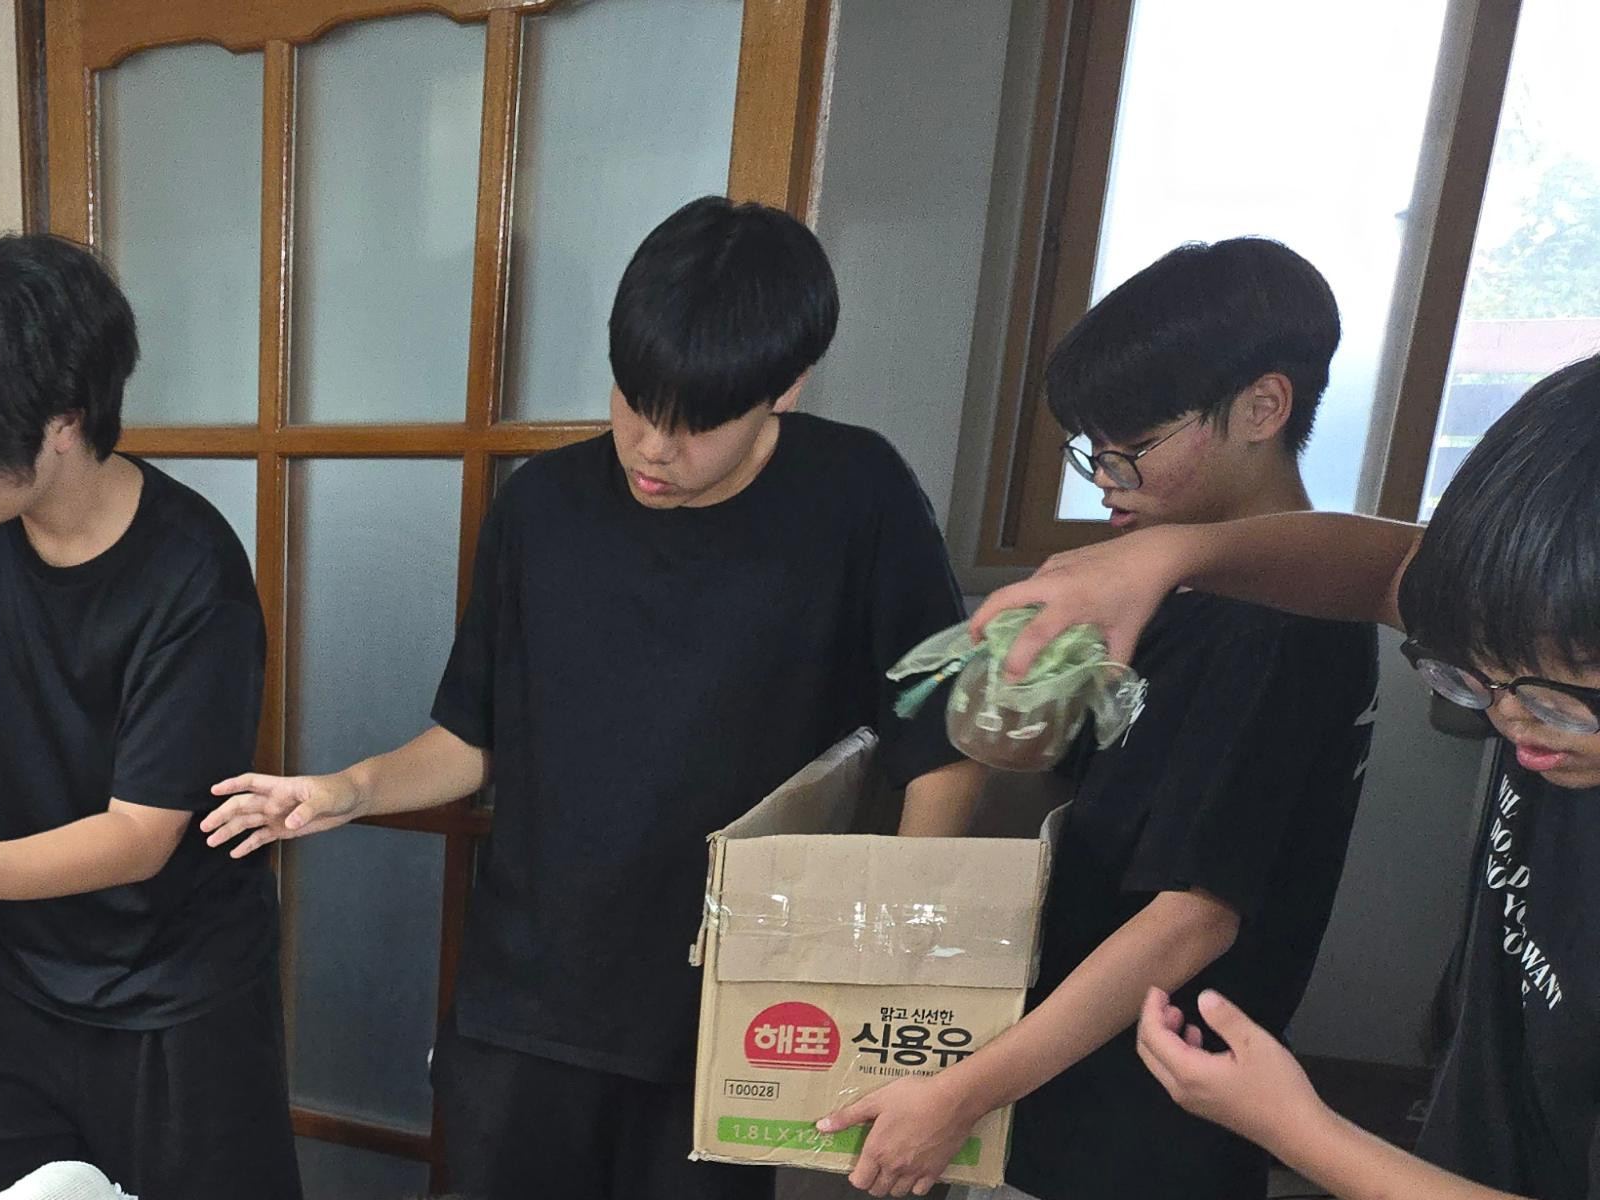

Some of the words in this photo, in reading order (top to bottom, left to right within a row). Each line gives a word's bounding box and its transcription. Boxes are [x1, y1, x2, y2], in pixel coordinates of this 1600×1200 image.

[880, 1007, 908, 1022] 맑고
[911, 1008, 954, 1025] 신선한
[754, 1023, 831, 1055] 해표
[851, 1022, 975, 1068] 식용유
[728, 1083, 775, 1098] 100028
